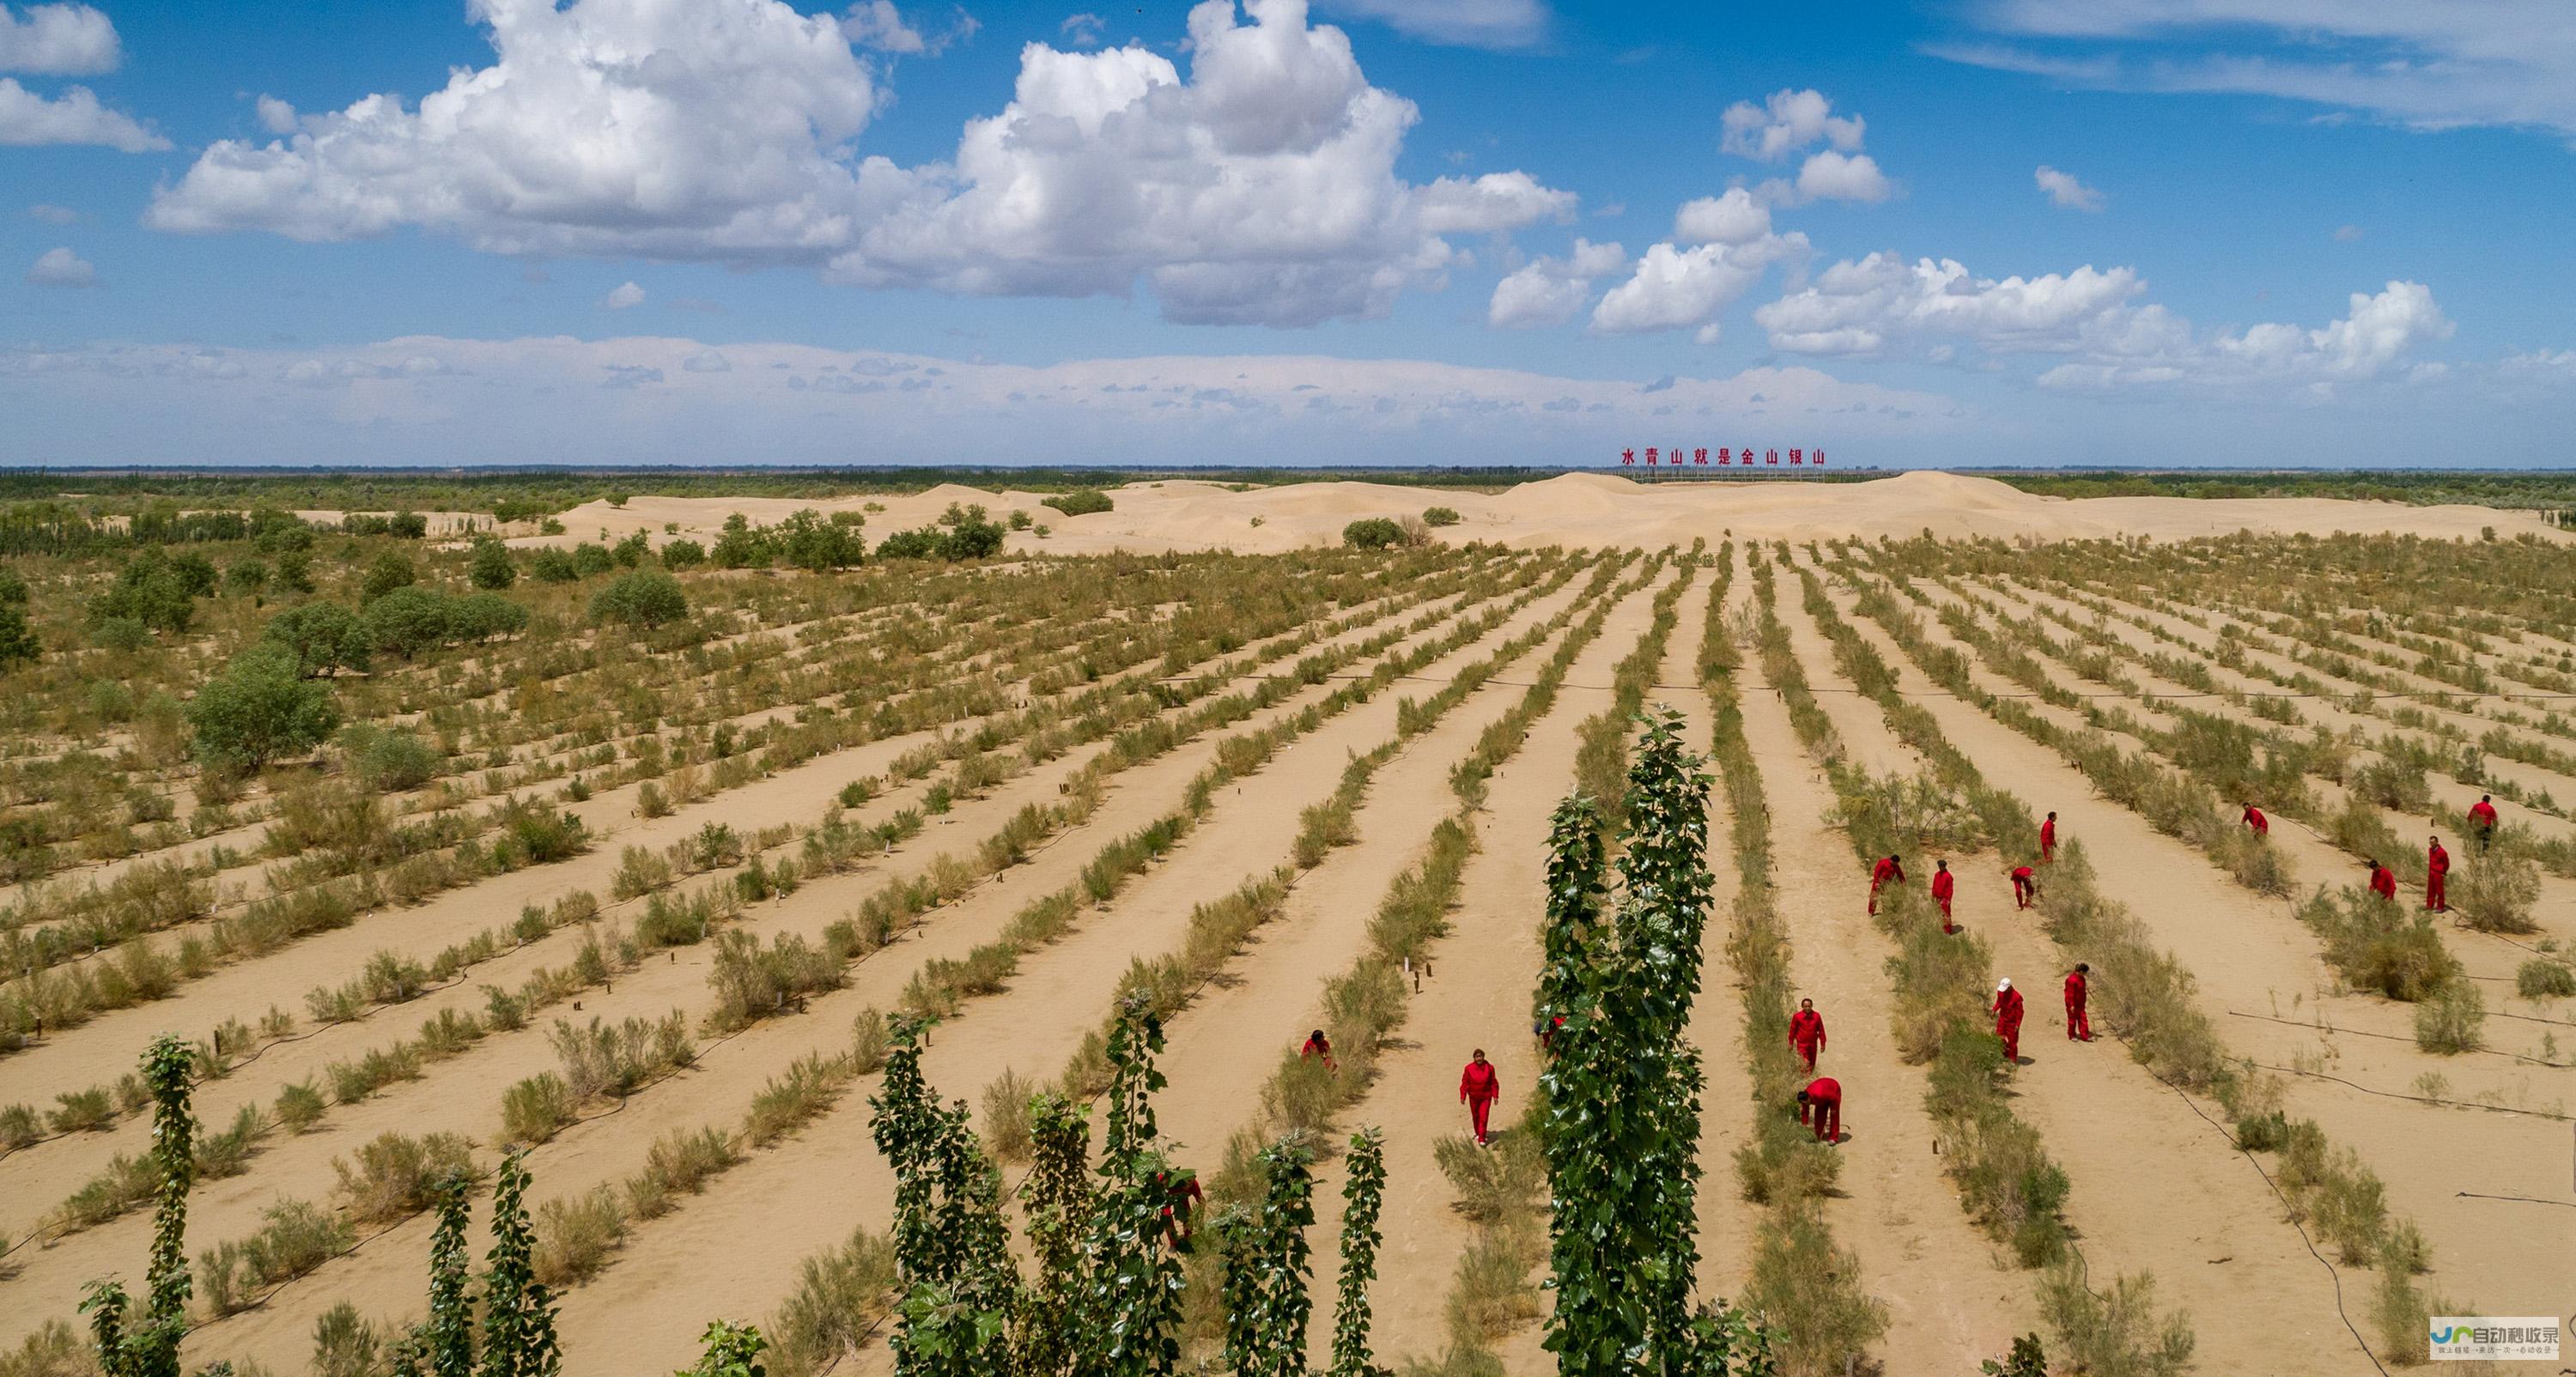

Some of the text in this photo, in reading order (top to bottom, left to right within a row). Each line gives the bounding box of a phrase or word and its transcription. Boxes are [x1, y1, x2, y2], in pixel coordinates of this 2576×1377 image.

[1621, 447, 1825, 465] 水青山就是金山银山
